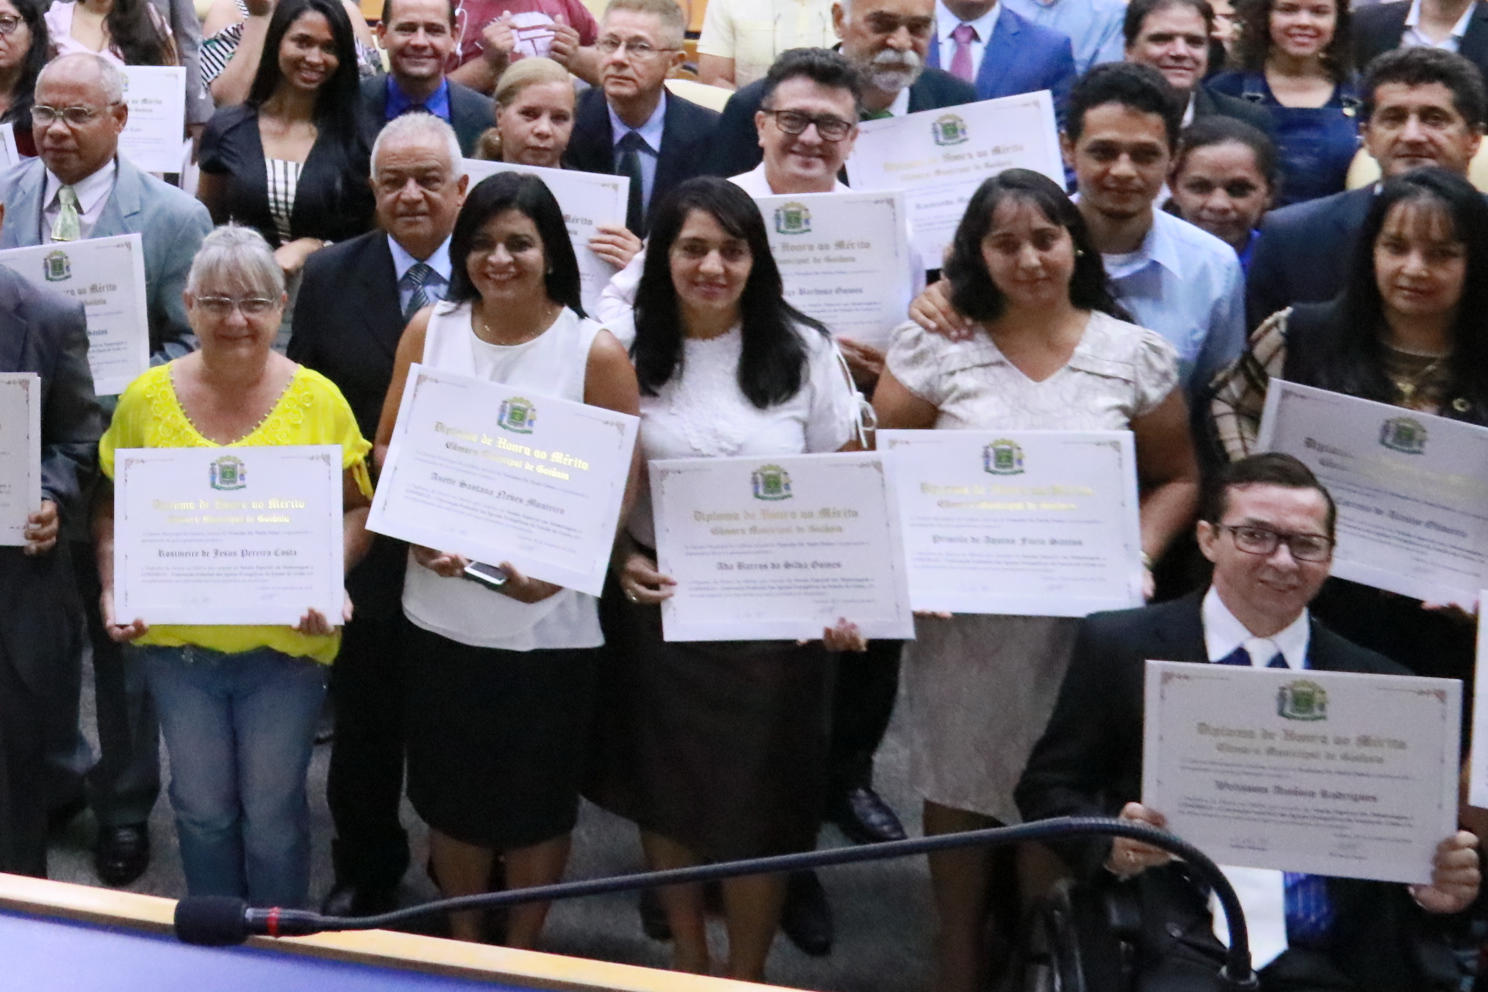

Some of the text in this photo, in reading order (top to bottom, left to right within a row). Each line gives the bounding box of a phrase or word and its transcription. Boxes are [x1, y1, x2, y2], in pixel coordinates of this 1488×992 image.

[90, 283, 117, 294] Mérito
[497, 437, 531, 455] Honra
[202, 549, 210, 557] de
